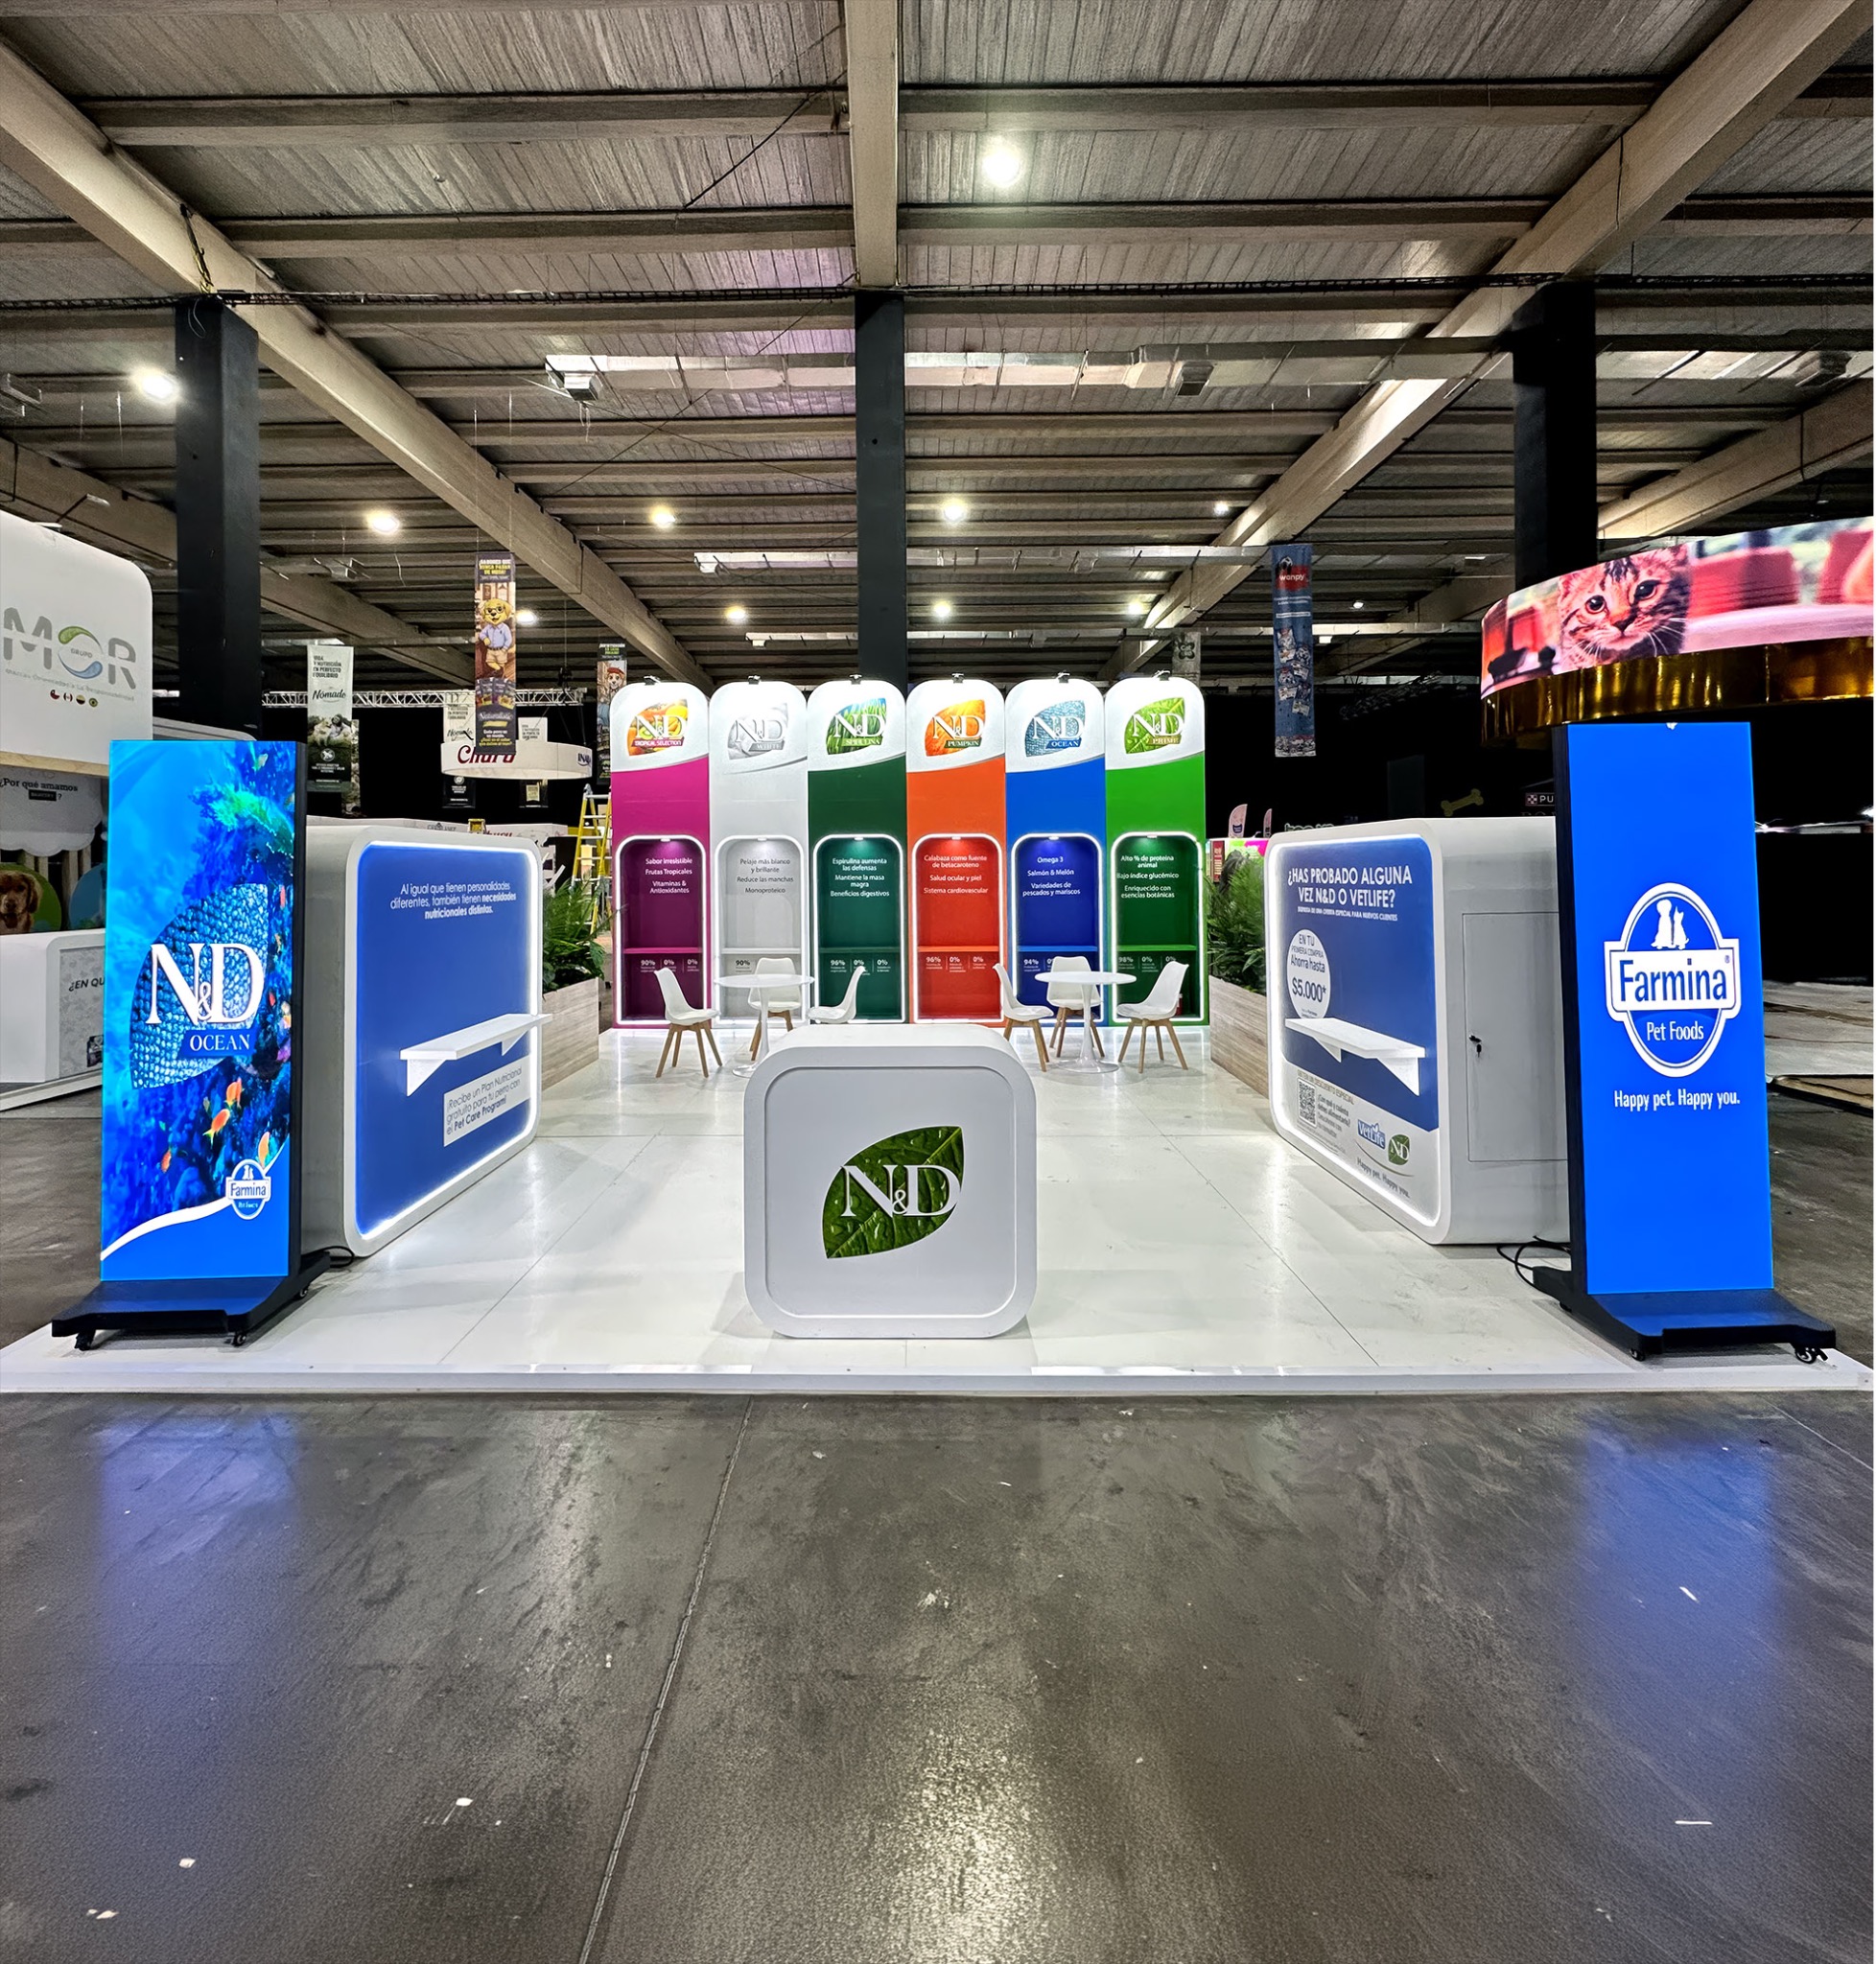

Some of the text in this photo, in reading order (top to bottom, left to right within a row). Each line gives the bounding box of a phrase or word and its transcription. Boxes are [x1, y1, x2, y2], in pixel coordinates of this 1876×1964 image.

[70, 648, 93, 658] GRUPO
[634, 714, 685, 739] N&D
[735, 718, 786, 743] N&D
[833, 713, 887, 738] N&D
[932, 715, 985, 739] N&D
[1032, 715, 1086, 740] N&D
[1131, 713, 1185, 737] N&D
[22, 781, 39, 790] qué
[40, 783, 78, 792] amamos
[832, 858, 860, 866] Espirulina
[1288, 865, 1412, 886] ¿HAS PROBADO ALGUNA
[400, 880, 511, 897] Al igual que tienen personalidades
[1298, 887, 1396, 908] VEZ N&D O VETLIFE?
[390, 892, 516, 910] diferentes, también tienen necesidades
[424, 905, 493, 920] nutricionales distintas.
[1299, 934, 1315, 947] EN TU
[1290, 954, 1325, 973] Ahorra hasta
[69, 979, 89, 992] ¿EN
[146, 943, 265, 1026] N&D
[1619, 958, 1727, 1002] Farmina
[1647, 1021, 1704, 1041] Pet Foods
[189, 1034, 250, 1052] OCEAN
[472, 1088, 480, 1098] un
[481, 1081, 494, 1094] Plan
[494, 1066, 522, 1087] Nutricional
[446, 1078, 520, 1125] gratuito para tu perro con
[1614, 1088, 1741, 1112] Happy pet. Happy you.
[446, 1125, 453, 1135] el
[454, 1118, 465, 1131] Pet
[466, 1111, 481, 1124] Care
[1359, 1122, 1385, 1147] VetLife
[231, 1182, 266, 1196] Farmina
[840, 1164, 961, 1218] N&D
